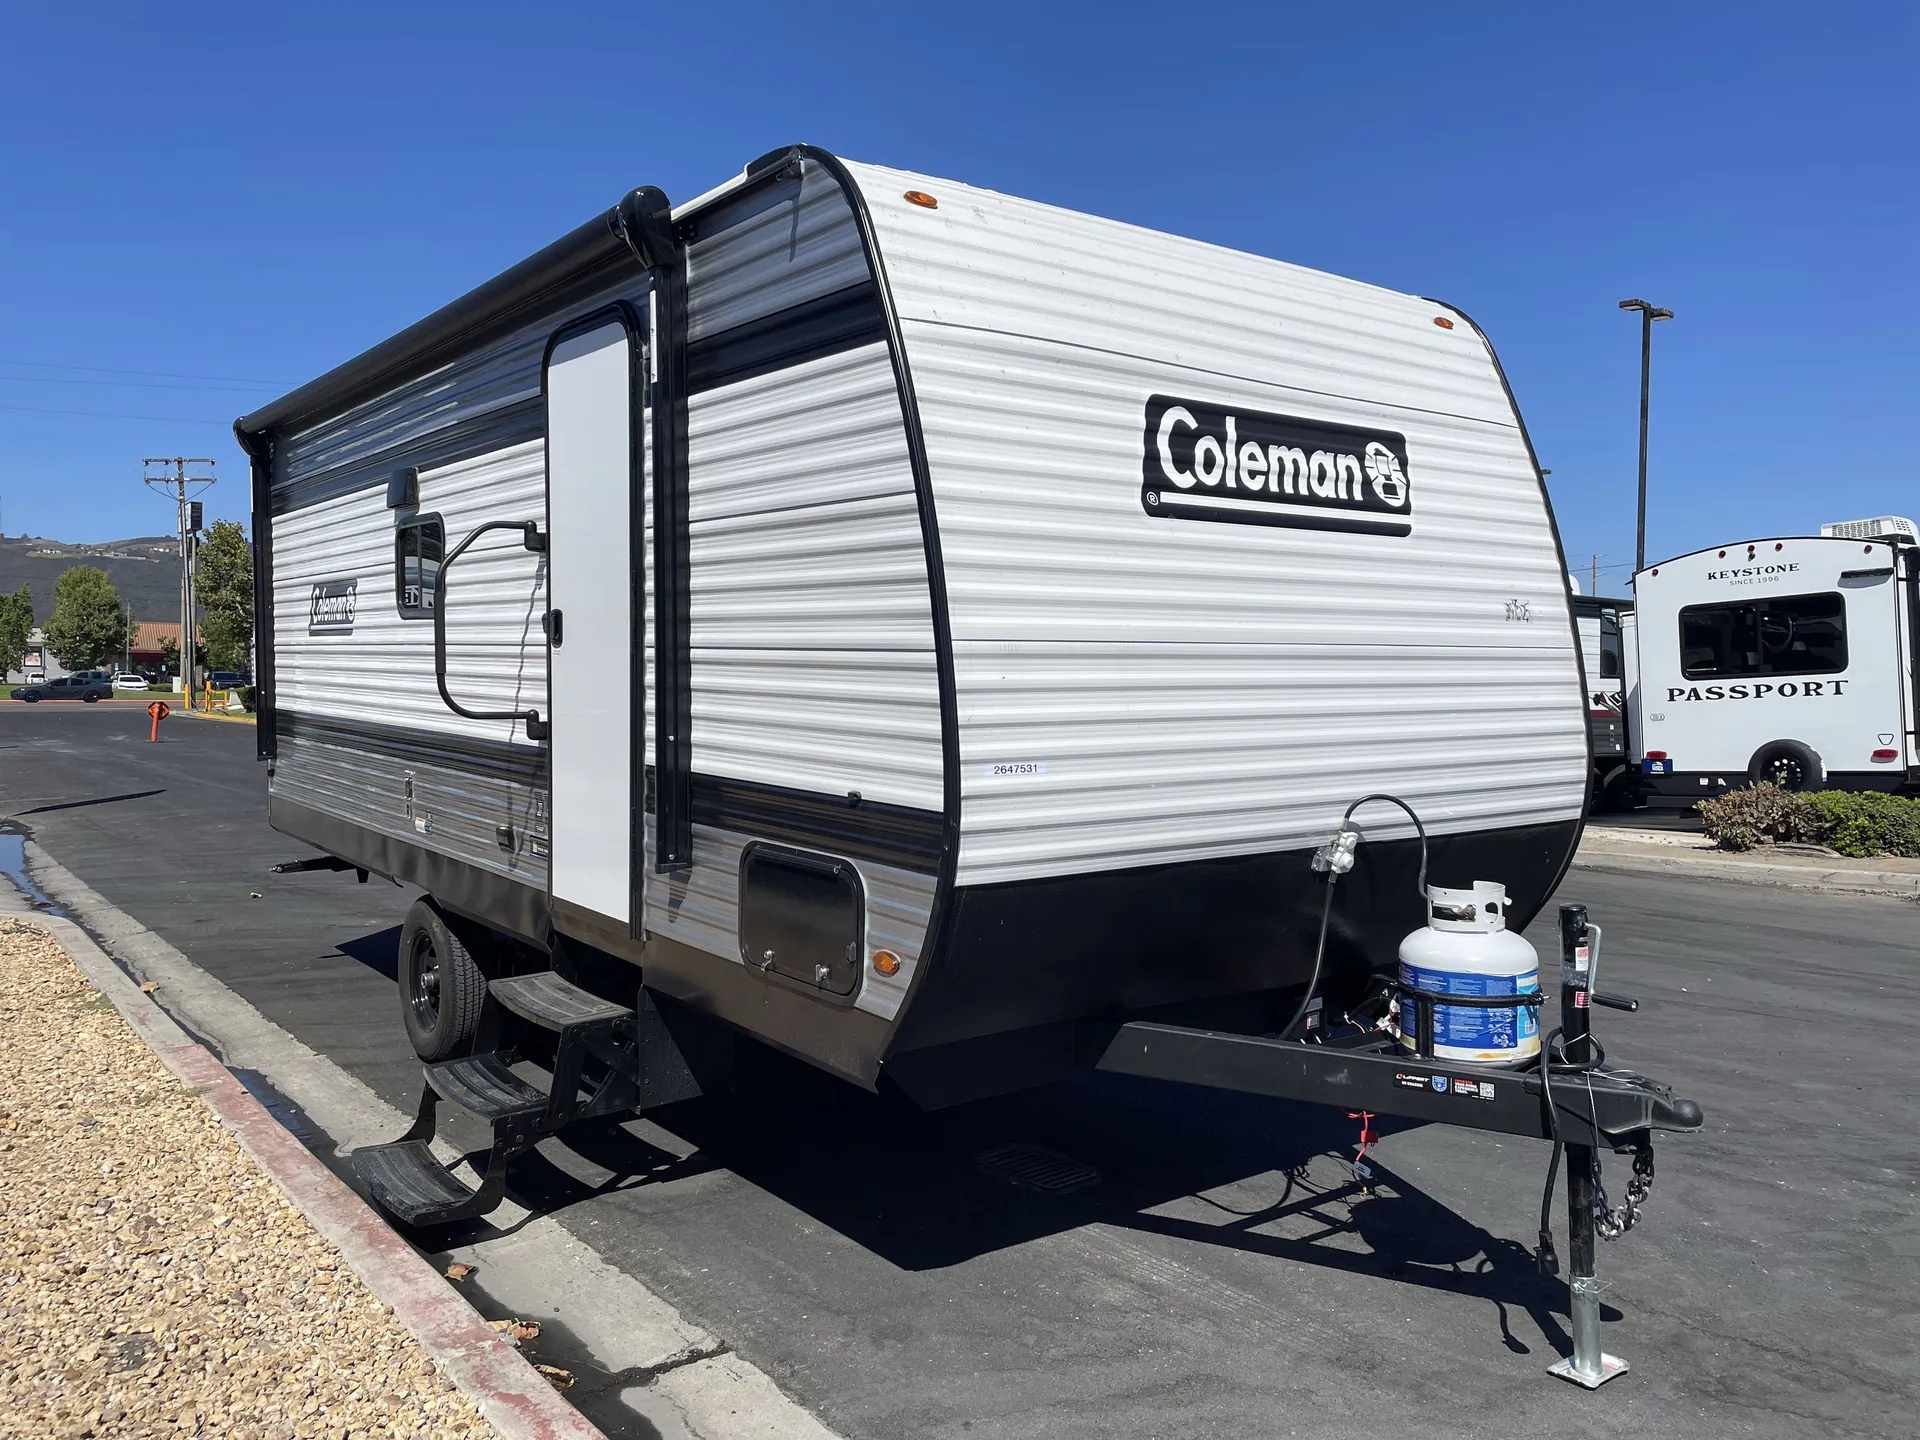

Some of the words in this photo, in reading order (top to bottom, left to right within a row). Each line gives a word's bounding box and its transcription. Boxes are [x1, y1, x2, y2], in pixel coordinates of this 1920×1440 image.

[1156, 406, 1363, 501] Coleman
[1707, 562, 1800, 580] KEYSTONE
[1729, 578, 1754, 586] SINCE
[1757, 575, 1779, 584] 1996
[311, 587, 347, 624] Coleman
[1667, 680, 1849, 702] PASSPORT
[993, 763, 1038, 775] 2647531
